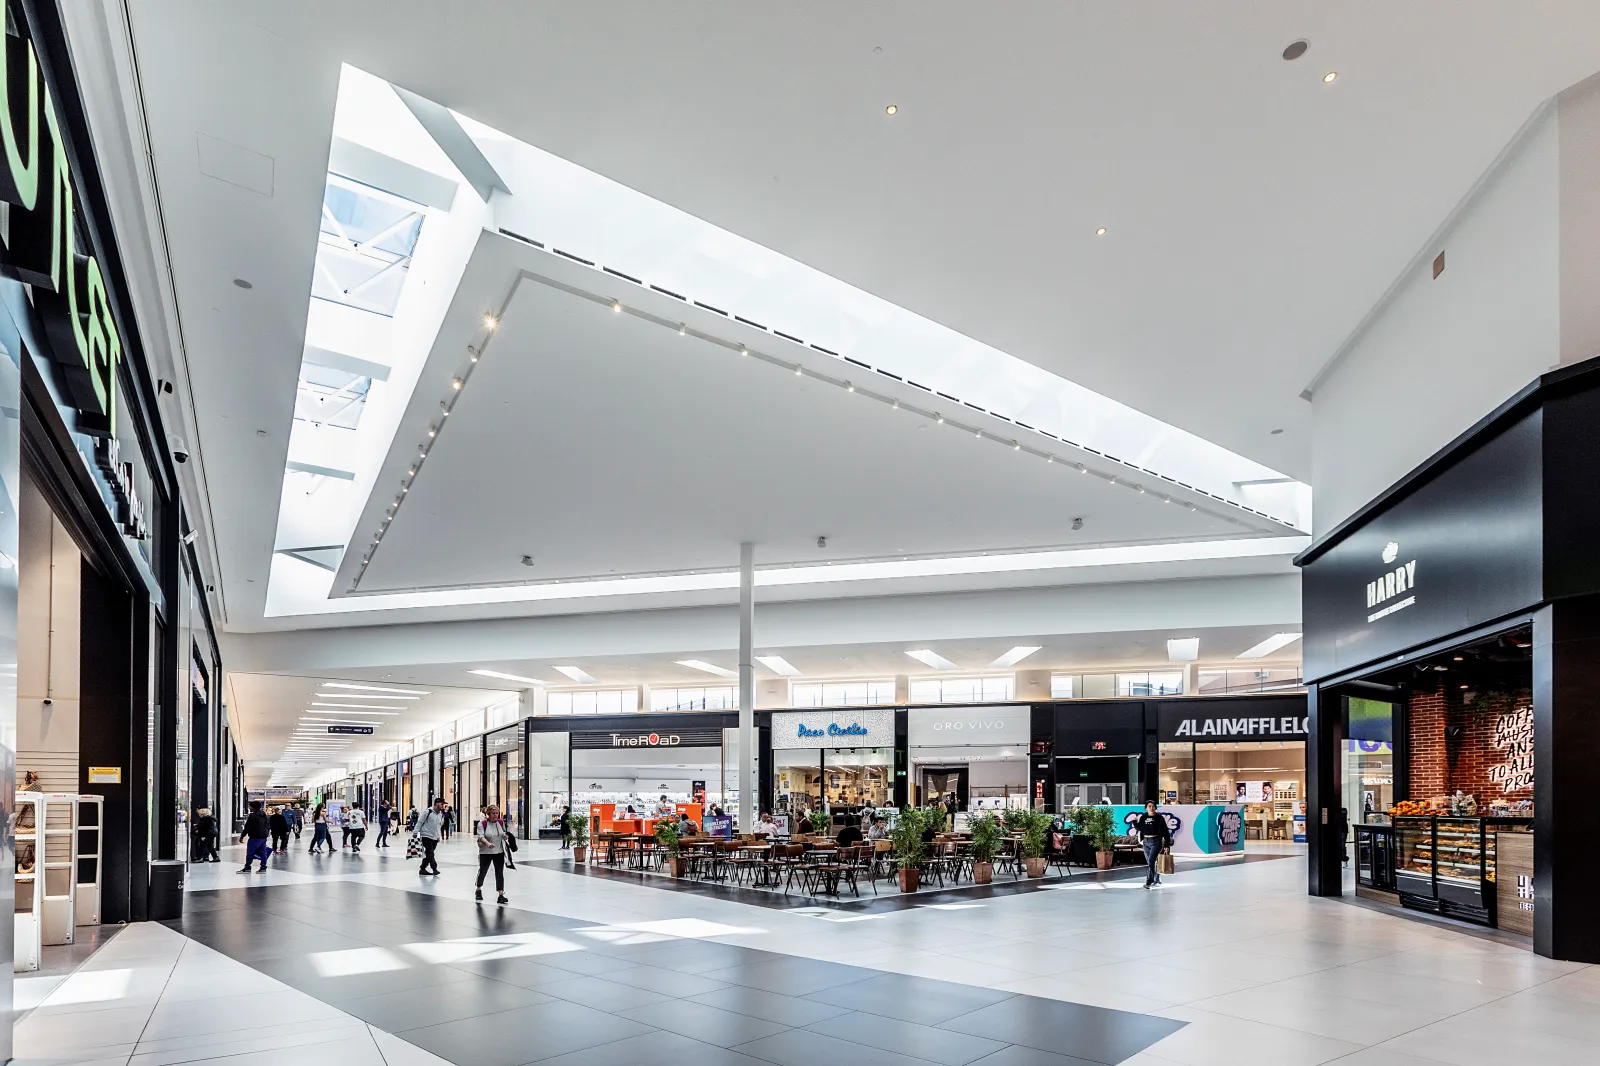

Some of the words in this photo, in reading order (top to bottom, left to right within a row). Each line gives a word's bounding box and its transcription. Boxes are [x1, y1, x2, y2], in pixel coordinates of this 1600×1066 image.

[1366, 559, 1417, 609] HARRY
[933, 721, 963, 731] ORO
[968, 720, 1004, 730] VIVO
[1496, 706, 1534, 735] COFF
[1489, 765, 1506, 782] TO
